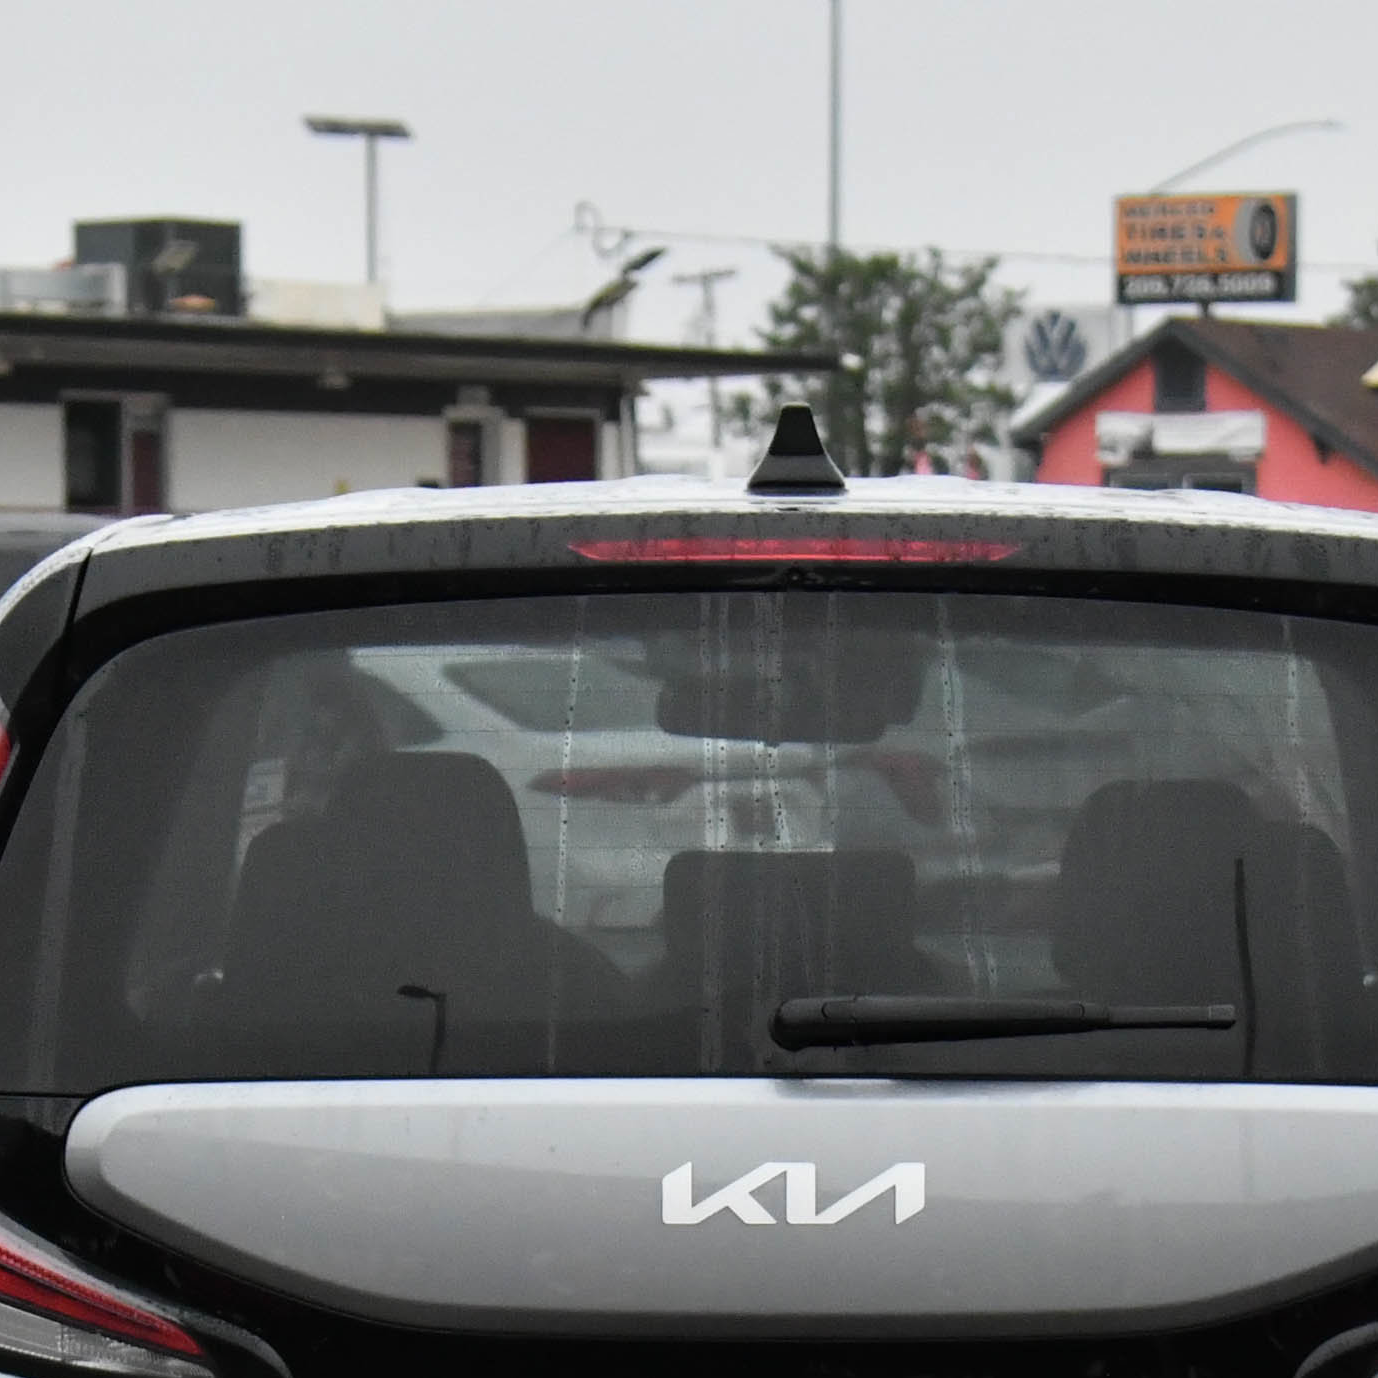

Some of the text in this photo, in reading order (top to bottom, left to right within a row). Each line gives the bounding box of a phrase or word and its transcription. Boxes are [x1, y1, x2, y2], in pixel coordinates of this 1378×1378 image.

[1125, 223, 1207, 240] TIRES
[1124, 248, 1229, 264] WHEELS
[661, 1161, 926, 1225] KIA
